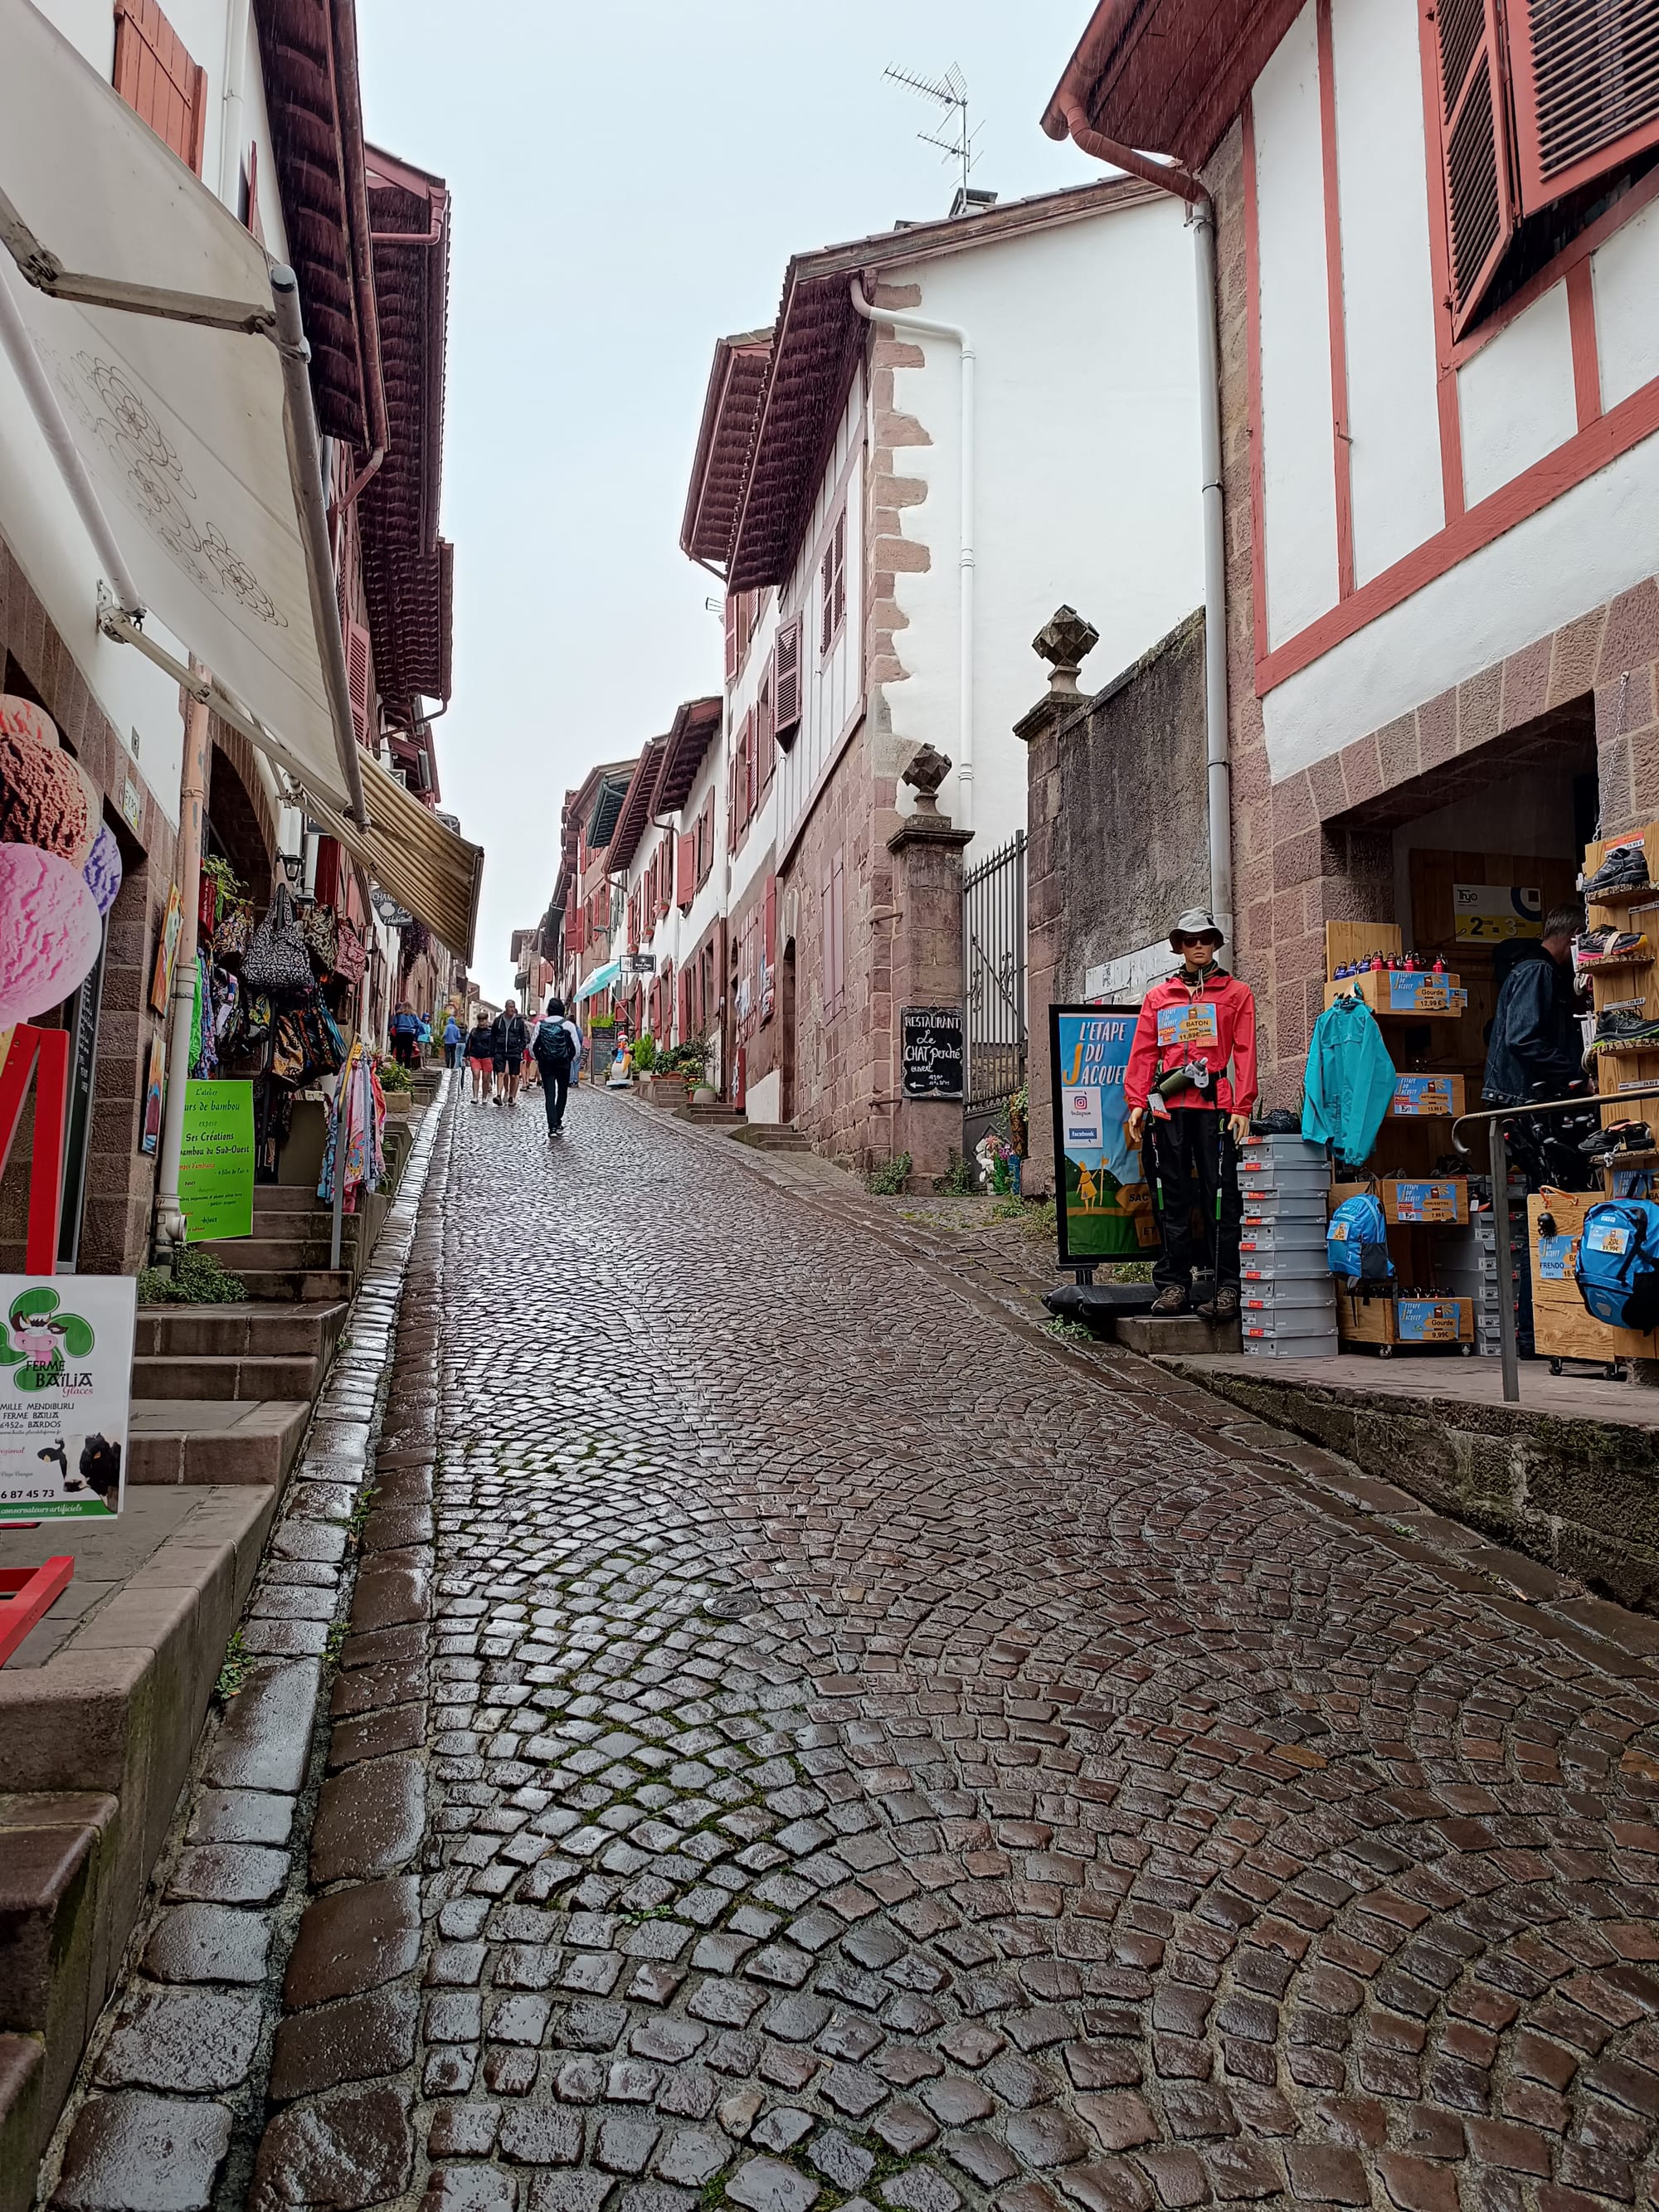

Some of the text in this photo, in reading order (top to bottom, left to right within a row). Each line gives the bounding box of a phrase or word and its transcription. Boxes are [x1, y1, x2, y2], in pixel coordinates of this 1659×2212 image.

[1470, 916, 1484, 936] 2
[1506, 917, 1518, 936] 3
[904, 1016, 960, 1028] RESTAURANT
[917, 1029, 937, 1044] Le
[1079, 1021, 1126, 1042] L'ETAPE
[905, 1046, 931, 1062] CHAT
[1084, 1043, 1104, 1062] DU
[199, 1101, 208, 1111] de
[211, 1100, 240, 1111] bambou
[186, 1130, 234, 1142] Ses Créations
[216, 1145, 250, 1155] Sud-Ouest
[27, 1360, 66, 1372] FERME
[62, 1386, 93, 1398] Glaces
[27, 1402, 75, 1410] MENDIBURU
[1, 1489, 55, 1500] 6 87 45 73
[1, 1503, 83, 1515] conservateurs artificiels
